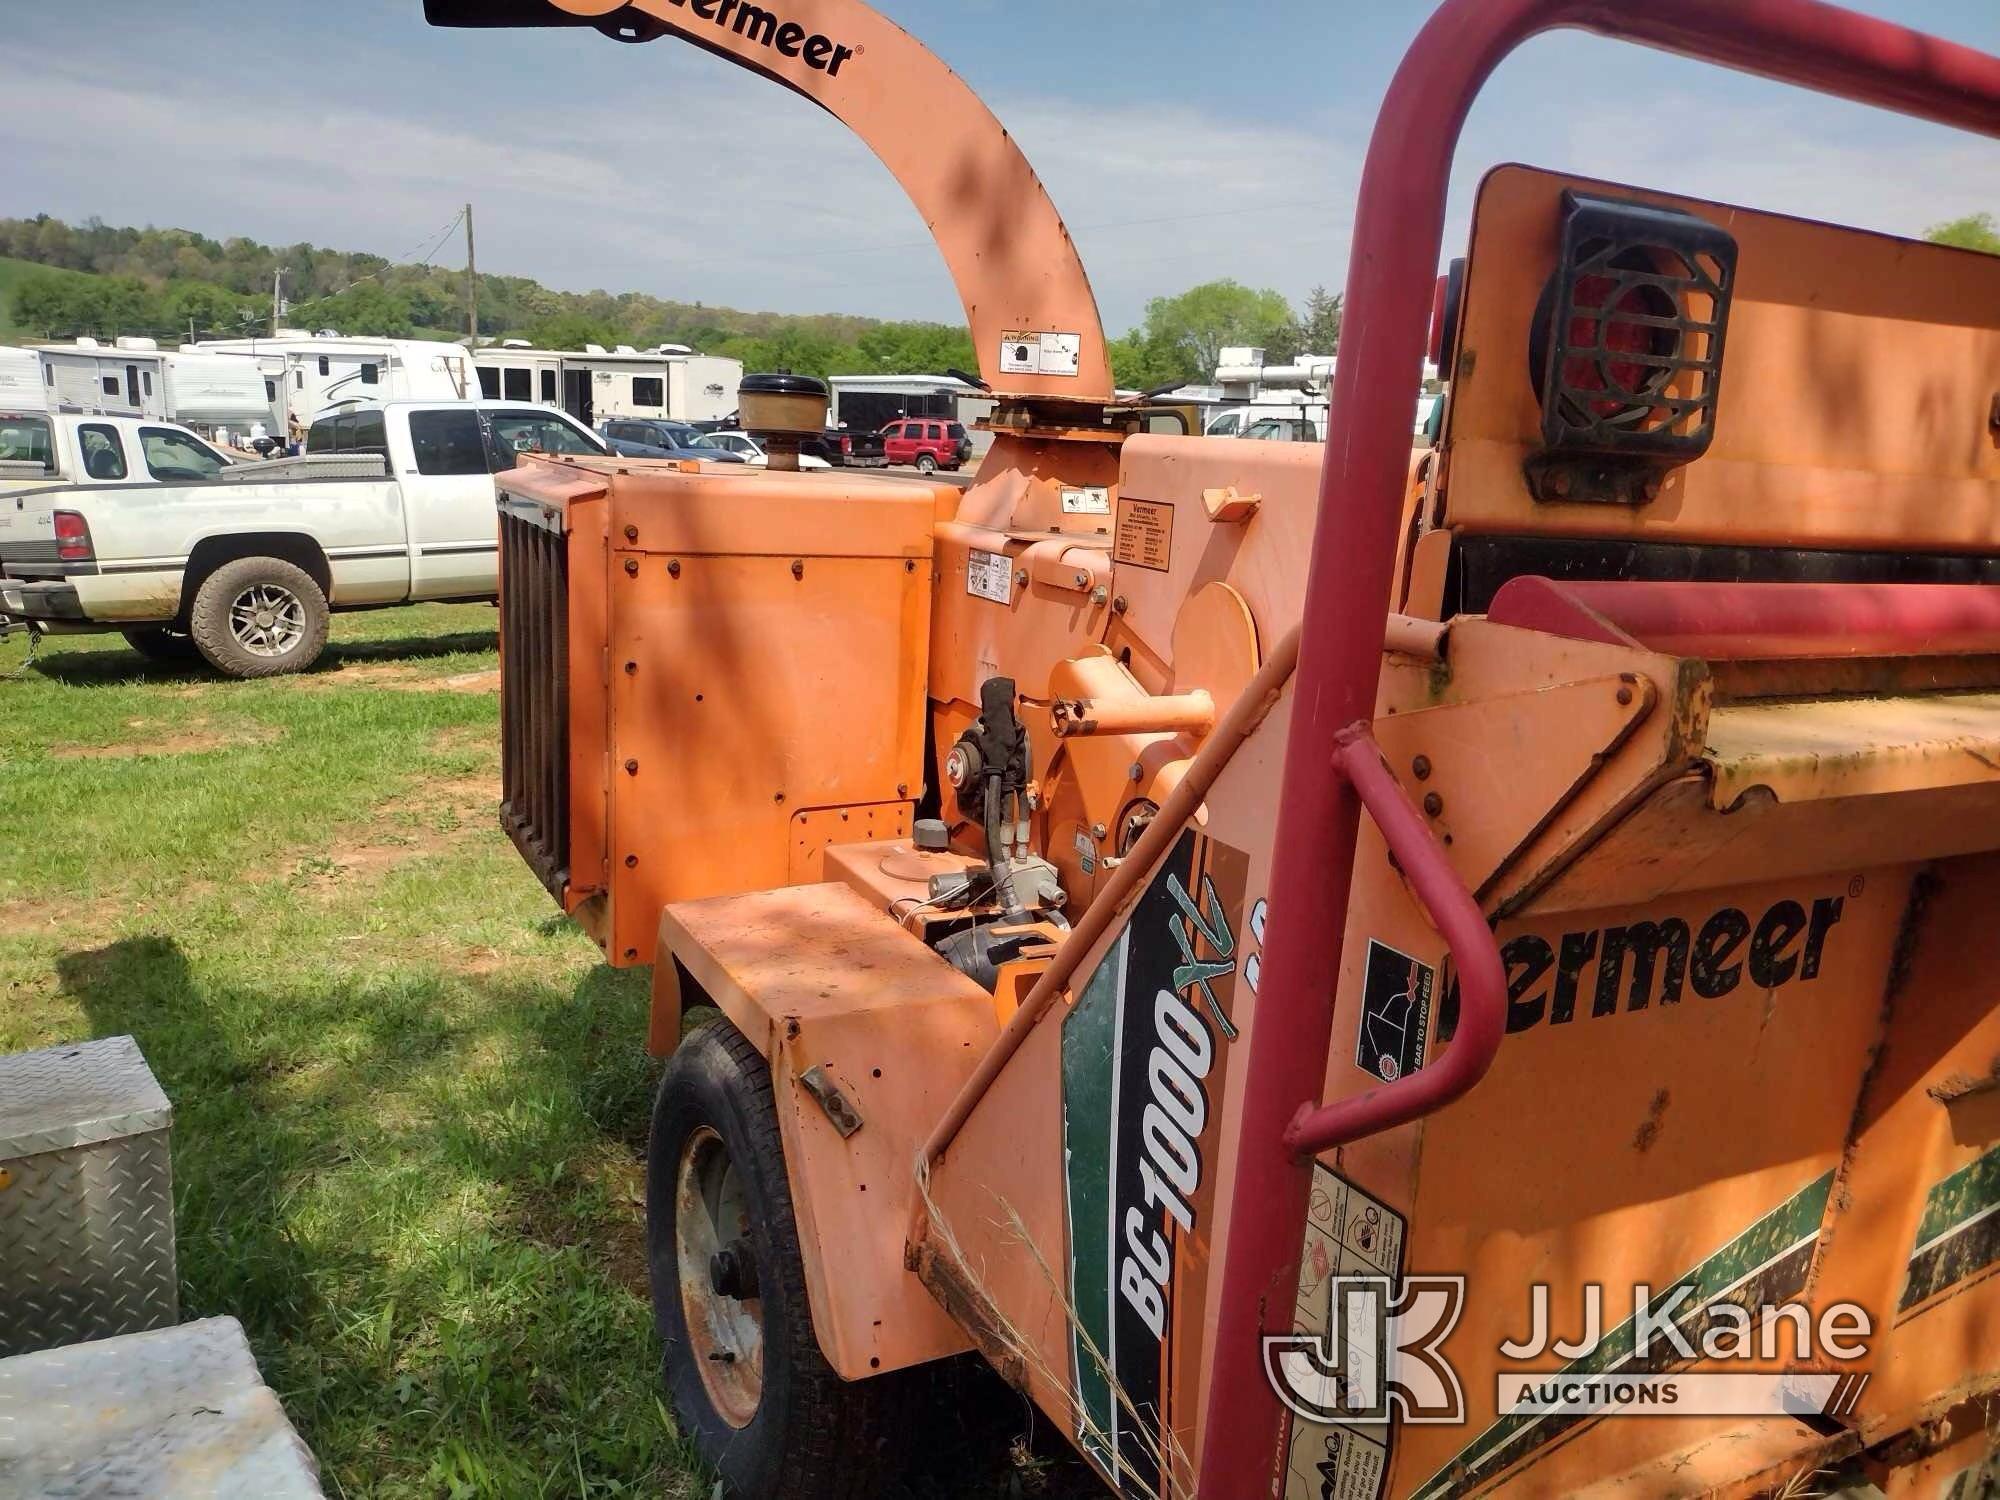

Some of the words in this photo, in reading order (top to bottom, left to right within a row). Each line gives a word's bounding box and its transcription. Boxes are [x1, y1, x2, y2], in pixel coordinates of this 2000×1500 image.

[668, 0, 852, 77] ermeer
[1422, 972, 1432, 999] FEED
[1418, 1000, 1427, 1027] STOP
[1416, 1027, 1425, 1043] TO
[1414, 1043, 1423, 1064] BAR
